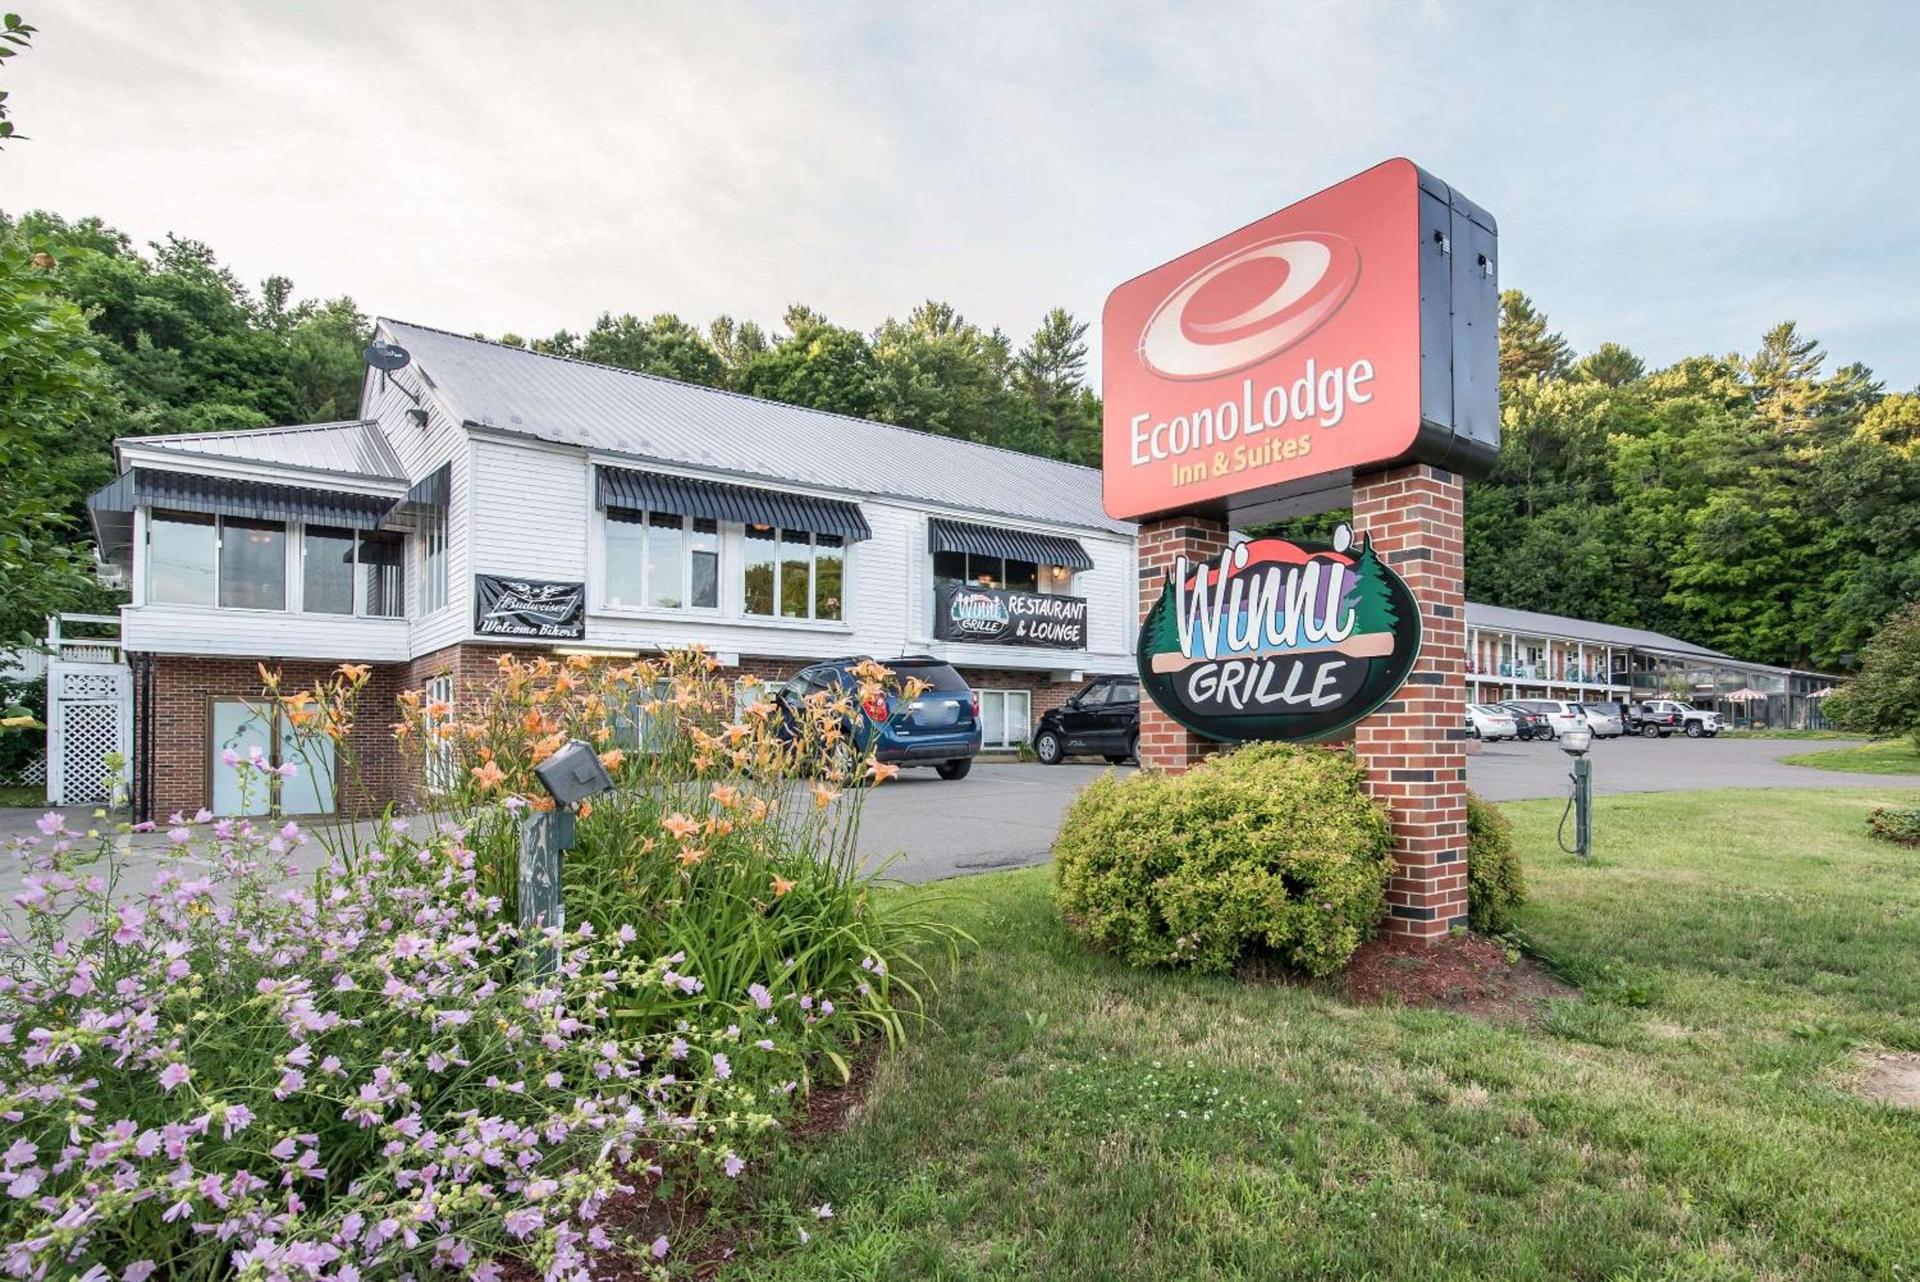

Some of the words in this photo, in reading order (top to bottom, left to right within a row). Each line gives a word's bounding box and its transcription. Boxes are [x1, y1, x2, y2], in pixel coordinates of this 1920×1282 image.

[1130, 358, 1374, 466] EconoLodge
[1172, 461, 1208, 487] Inn
[1212, 450, 1230, 477] &
[1233, 433, 1312, 472] Suites
[1175, 523, 1356, 660] Winni
[501, 597, 569, 613] Budweiser
[956, 592, 1001, 619] Winni
[1008, 595, 1087, 621] RESTAURANT
[480, 620, 538, 635] Welcome
[539, 623, 579, 637] Bikers
[962, 619, 999, 632] GRILLE
[1016, 620, 1026, 637] &
[1029, 620, 1081, 642] LOUNGE
[1188, 660, 1347, 710] GRILLE
